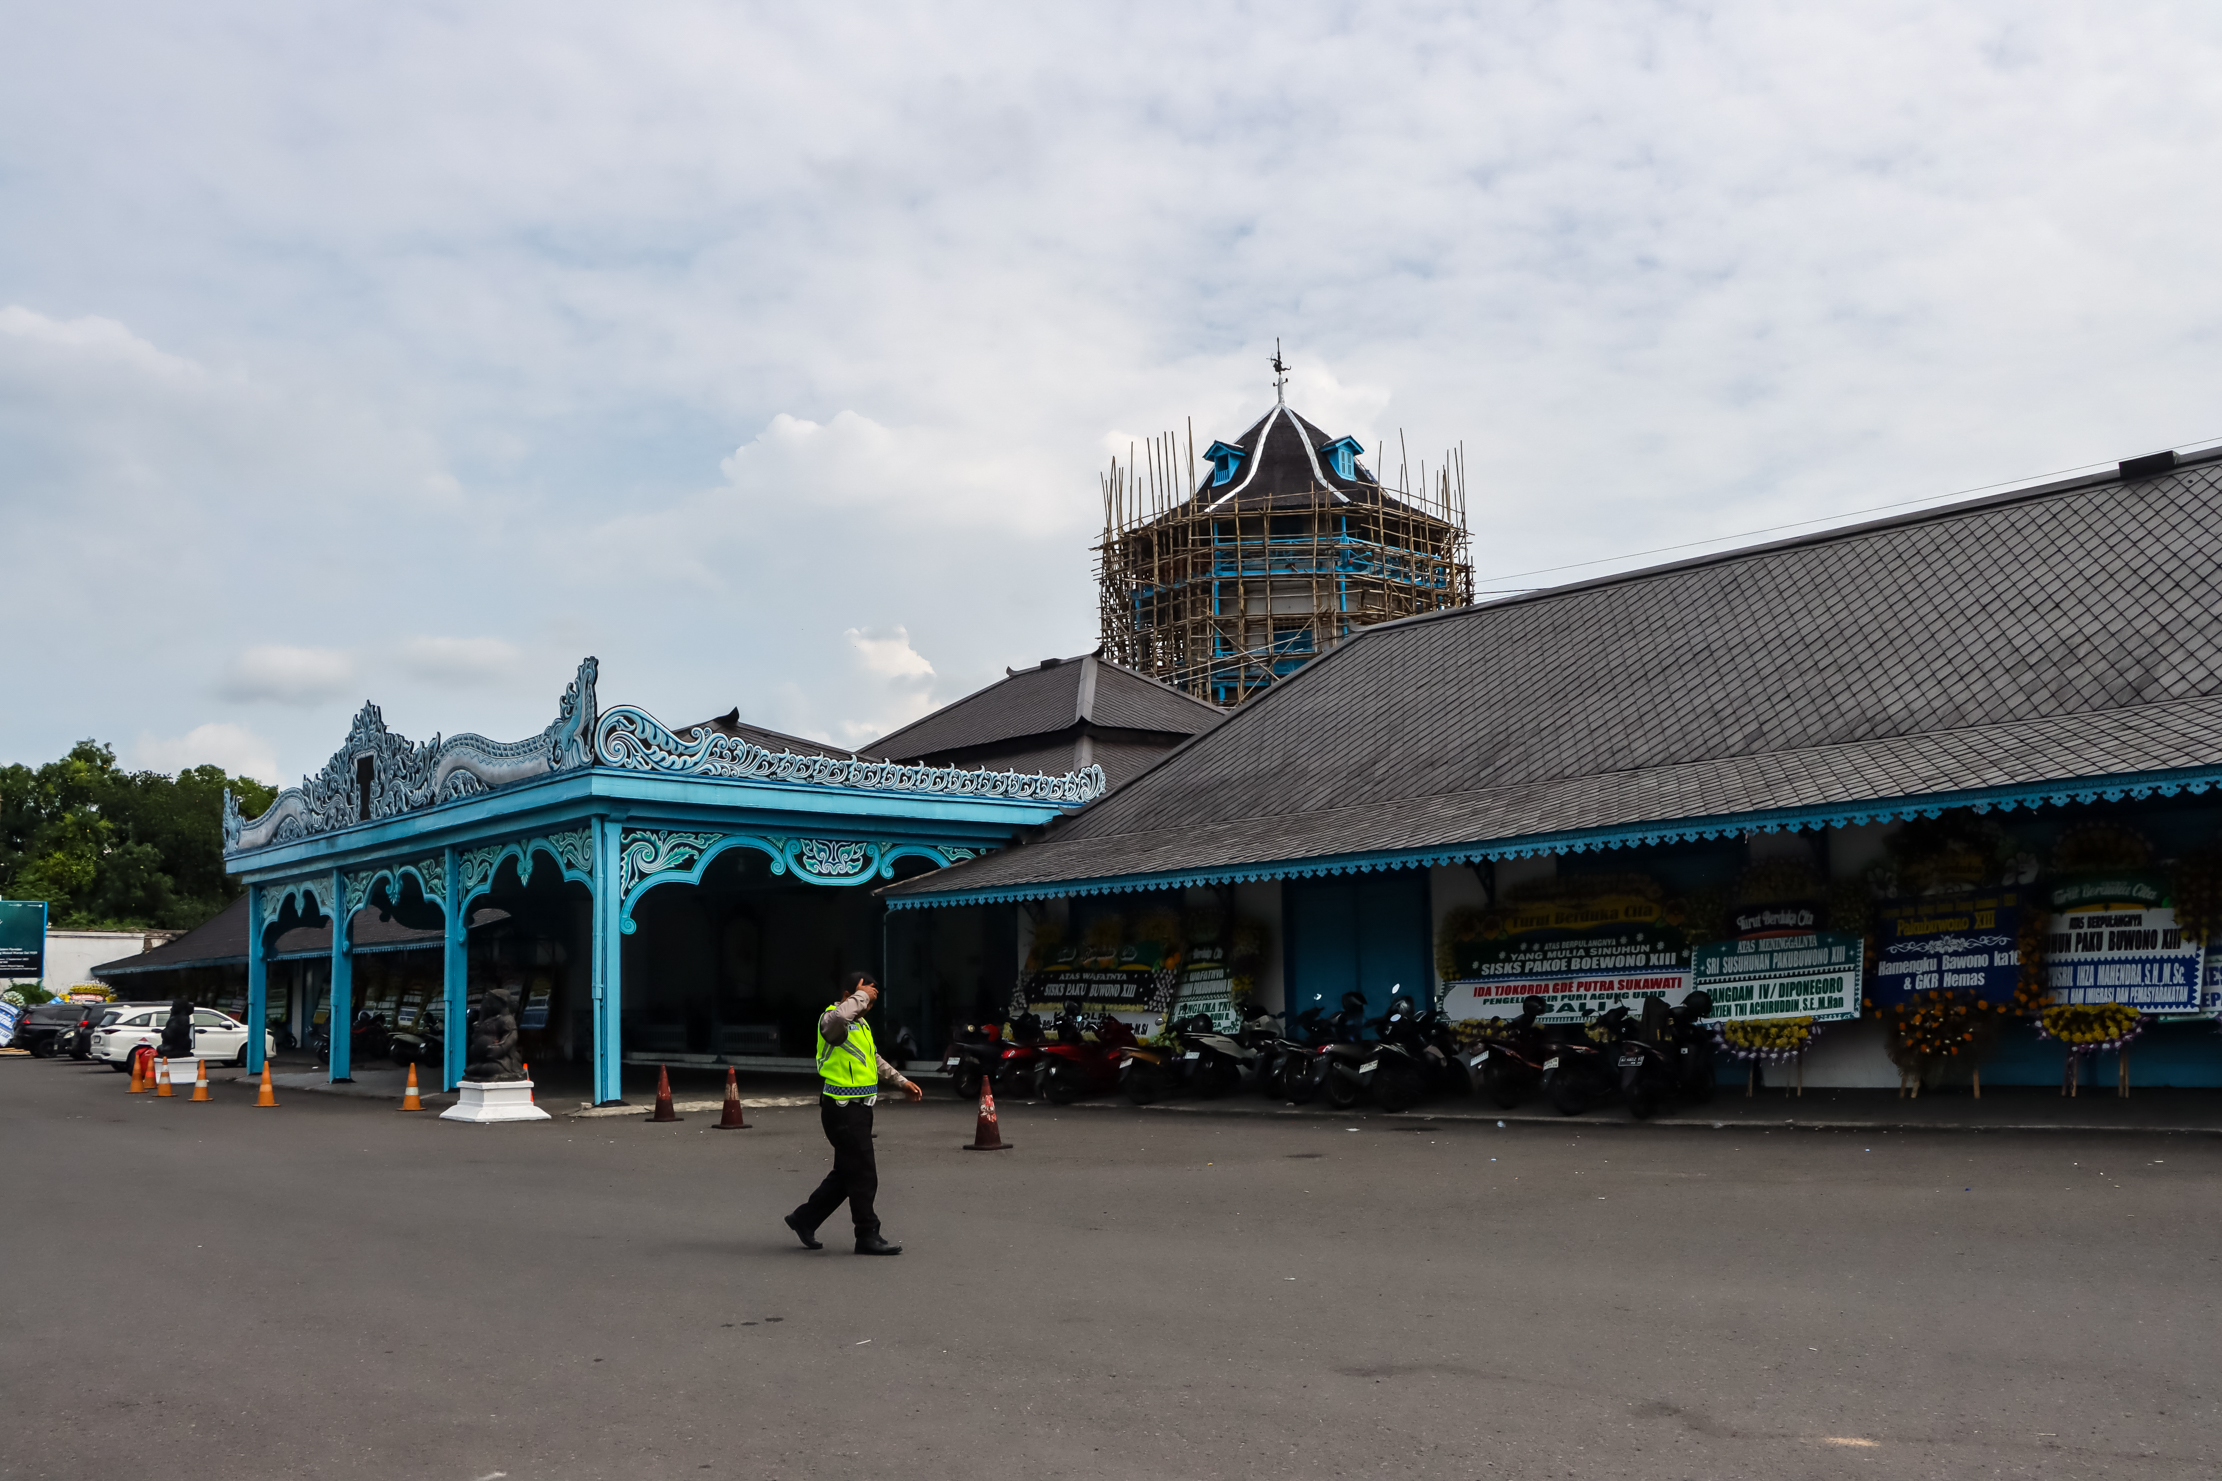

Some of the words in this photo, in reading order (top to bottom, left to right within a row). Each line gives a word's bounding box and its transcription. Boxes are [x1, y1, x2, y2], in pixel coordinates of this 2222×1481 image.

[1554, 907, 1619, 925] Berduka
[1623, 903, 1653, 919] Cita
[1896, 917, 1970, 937] Pakubuwono
[1974, 909, 1996, 930] XIII
[1544, 943, 1560, 952] ATAS
[1561, 938, 1617, 951] BERPULANGNYA
[1758, 934, 1818, 952] MENINGGALNYA
[2075, 931, 2103, 952] PAKU
[2108, 930, 2158, 951] BUWONO
[2161, 929, 2181, 950] XIII
[1510, 951, 1544, 962] YANG
[1547, 948, 1586, 960] MULIA
[1589, 943, 1651, 957] SINUHUN
[1706, 957, 1719, 975] SRI
[1722, 950, 1770, 974] SUSUHUNAN
[1772, 946, 1829, 970] PAKUBUWONO
[1831, 945, 1846, 964] XIII
[1481, 962, 1522, 976] SISKS
[1524, 958, 1569, 974] PAKOE
[1571, 953, 1647, 972] BOEWONO
[1649, 951, 1677, 968] XIII
[1878, 956, 1938, 976] Hamengku
[1942, 953, 1989, 971] Bawono
[1059, 972, 1081, 981] ATAS
[1082, 972, 1128, 981] WAFATNYA
[1903, 976, 1912, 990] &
[1943, 971, 1986, 988] Hemas
[1044, 983, 1066, 997] SISKS
[1066, 983, 1088, 997] PAKU
[1089, 983, 1121, 999] BUWONO
[1121, 983, 1138, 999] XIII
[1473, 986, 1492, 997] IDA
[1494, 983, 1550, 996] TJOKORDA
[1552, 982, 1574, 994] GDE
[1576, 980, 1615, 993] PUTRA
[1617, 977, 1682, 991] SUKAWATI
[1778, 976, 1843, 999] DIPONEGORO
[1218, 1001, 1231, 1012] TNI
[1560, 993, 1588, 1002] PURI
[1711, 1004, 1732, 1018] AYJEN
[1734, 1002, 1747, 1017] TNI
